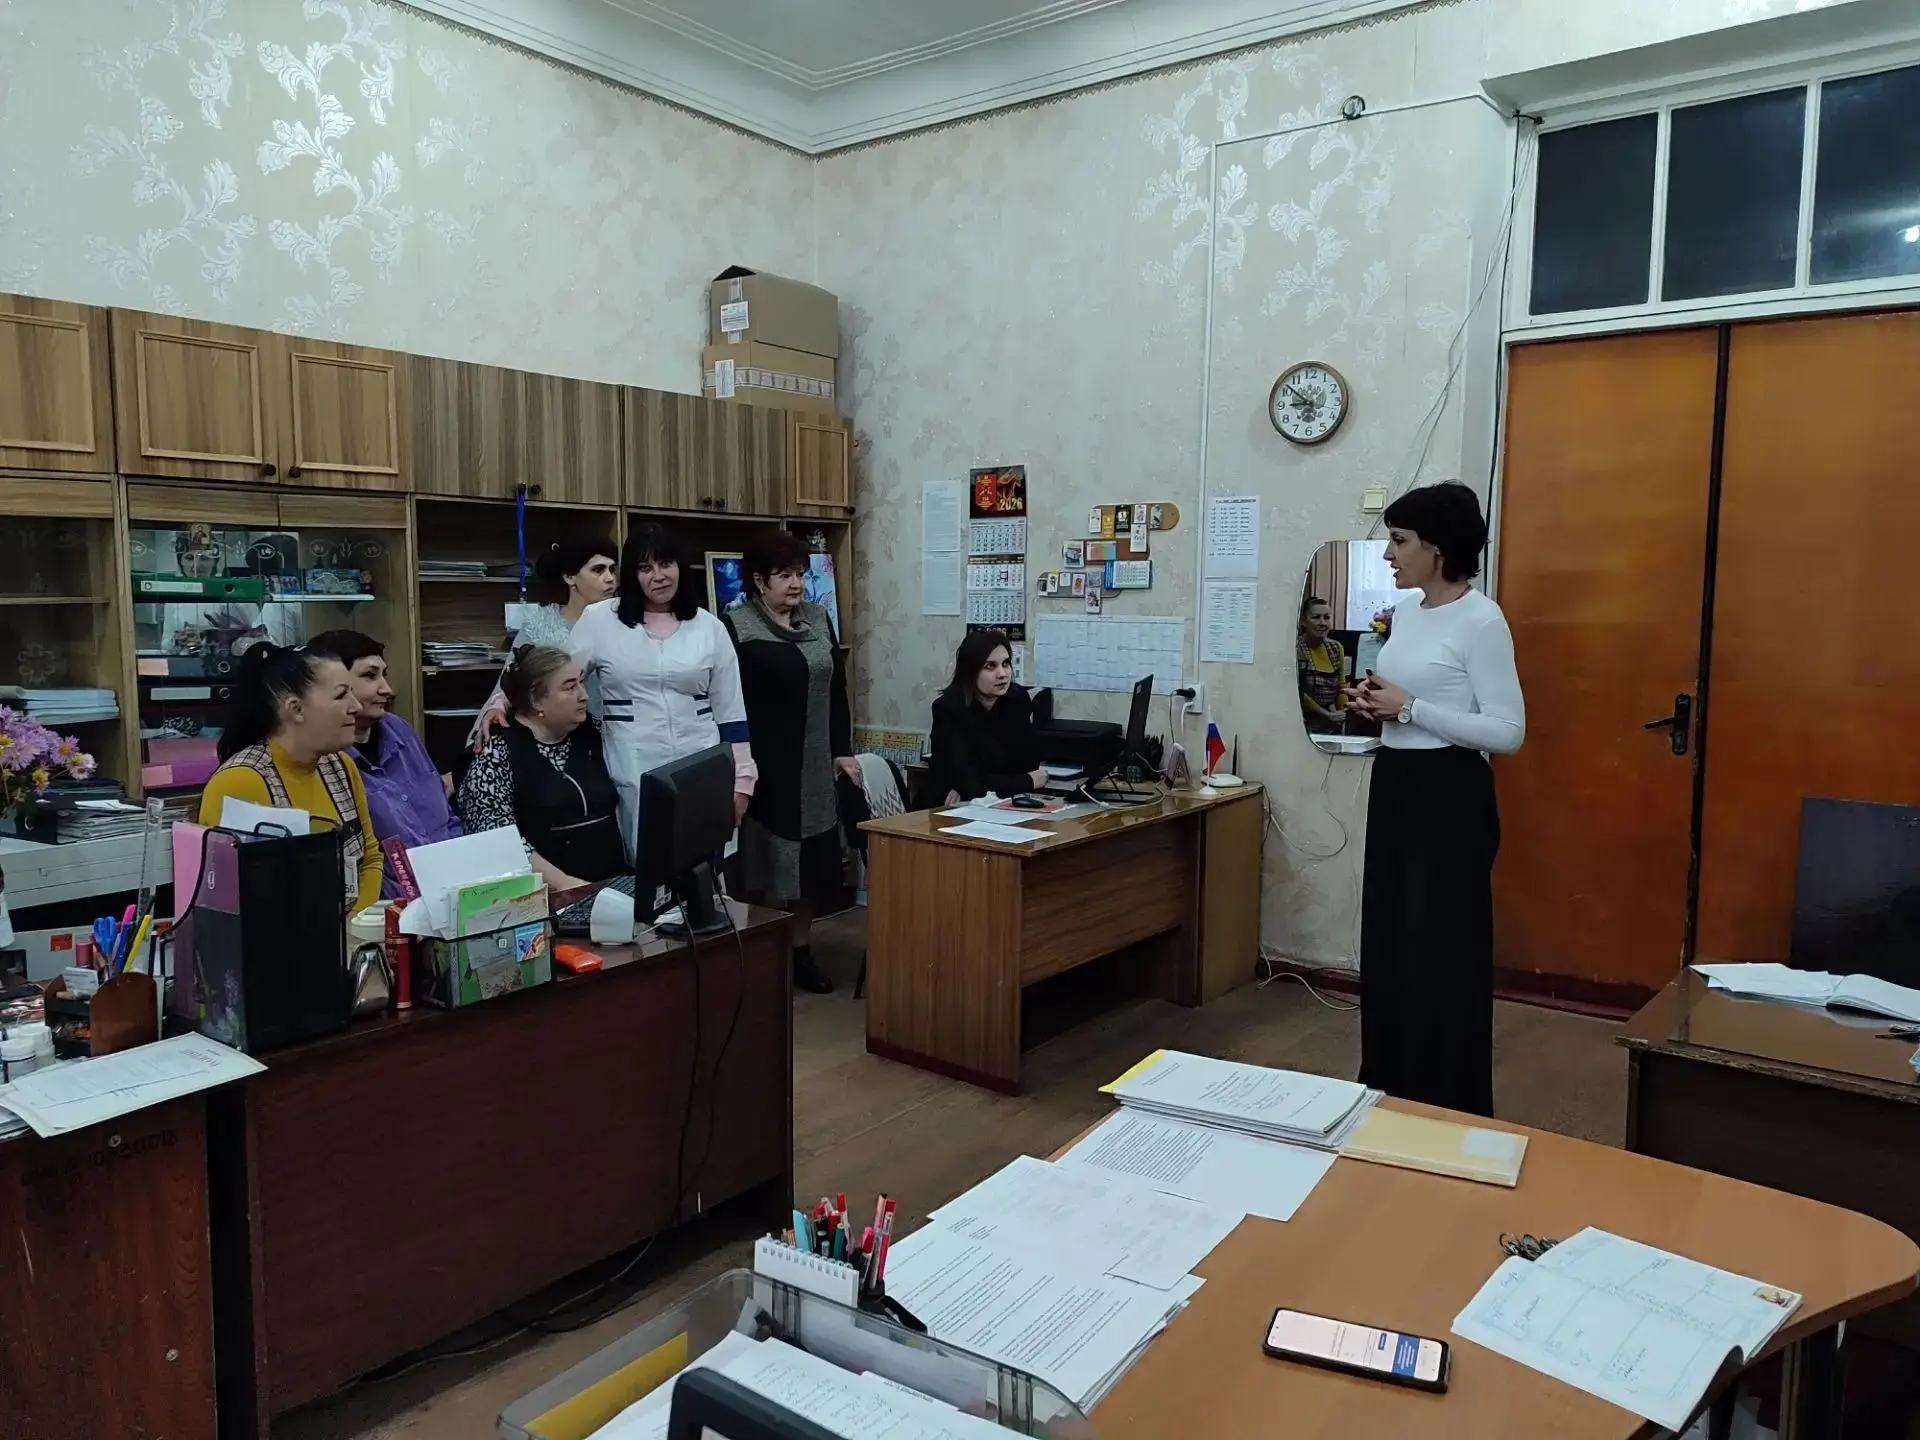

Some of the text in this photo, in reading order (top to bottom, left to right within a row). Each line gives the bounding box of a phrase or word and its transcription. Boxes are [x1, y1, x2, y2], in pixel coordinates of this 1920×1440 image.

[1305, 369, 1317, 379] 12
[1292, 375, 1301, 385] 11
[1282, 387, 1293, 397] 10
[1330, 383, 1337, 393] 2
[1277, 401, 1285, 410] 9
[1333, 397, 1342, 407] 3
[1282, 414, 1290, 423] 8
[1328, 411, 1336, 420] 4
[1292, 424, 1299, 434] 7
[1305, 427, 1312, 436] 6
[1319, 422, 1327, 432] 5
[1000, 497, 1023, 510] 2026
